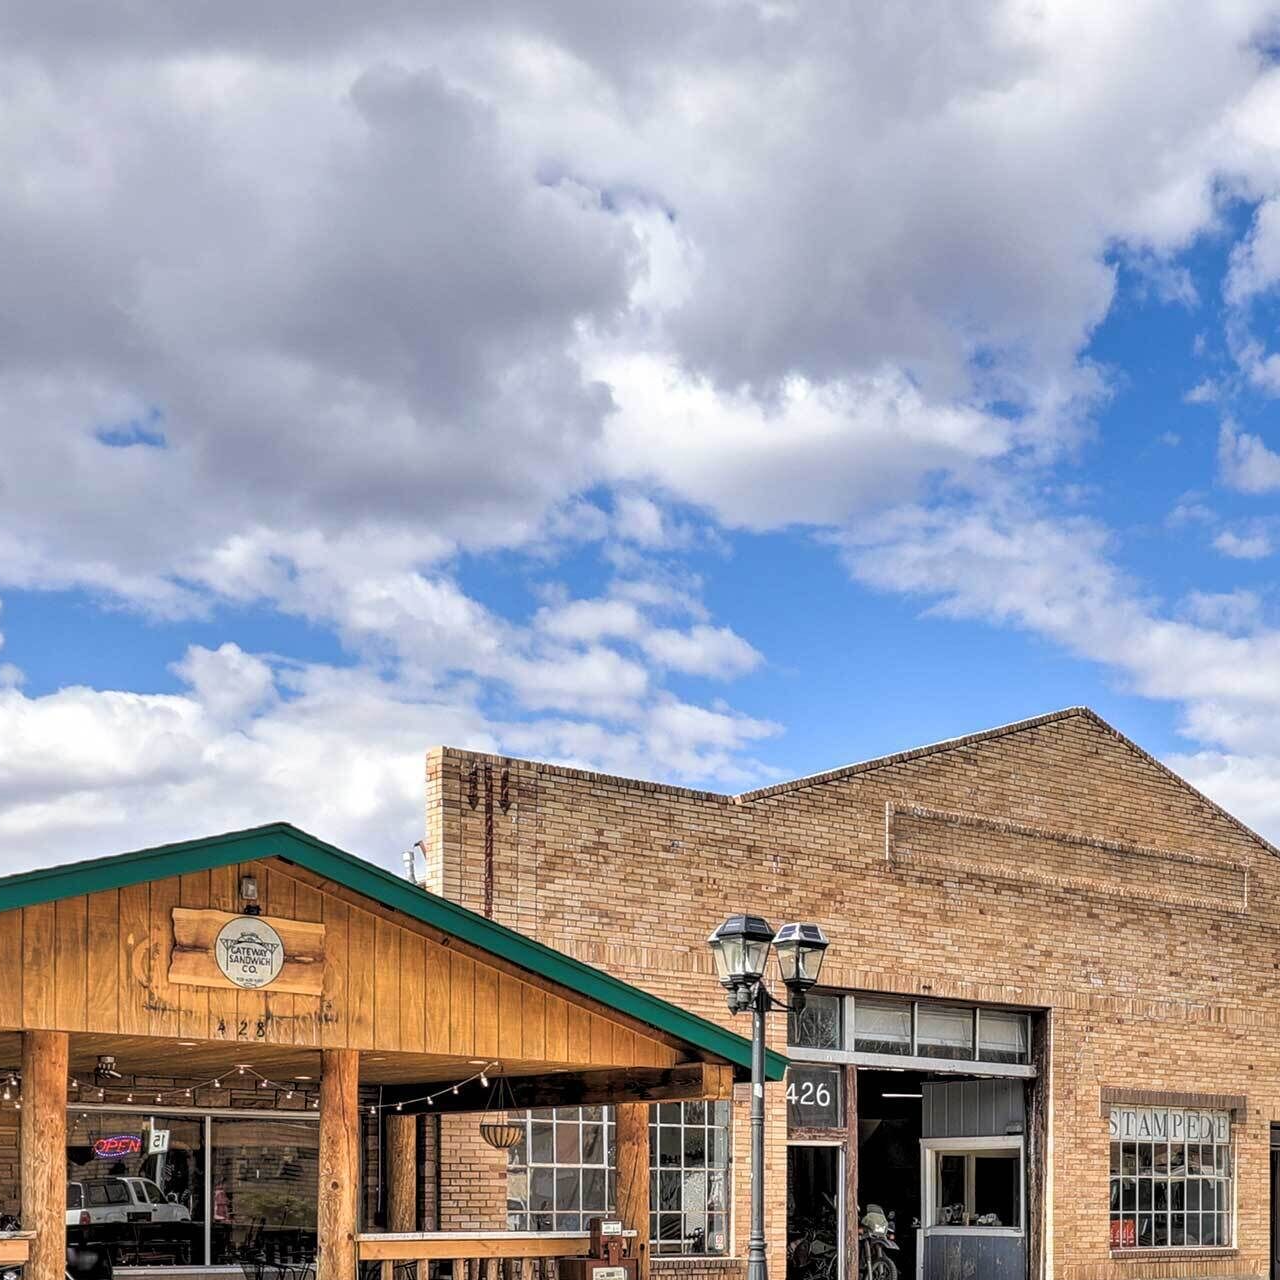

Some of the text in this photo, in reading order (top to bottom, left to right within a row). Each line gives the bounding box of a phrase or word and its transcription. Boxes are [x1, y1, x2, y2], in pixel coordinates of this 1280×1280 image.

[230, 946, 267, 957] GATEWAY
[229, 955, 271, 966] SANDWICH
[241, 965, 258, 975] CO.
[218, 1019, 266, 1037] 428
[786, 1082, 830, 1107] 426
[1109, 1110, 1227, 1141] STAMPEDE
[93, 1138, 142, 1153] OPEN
